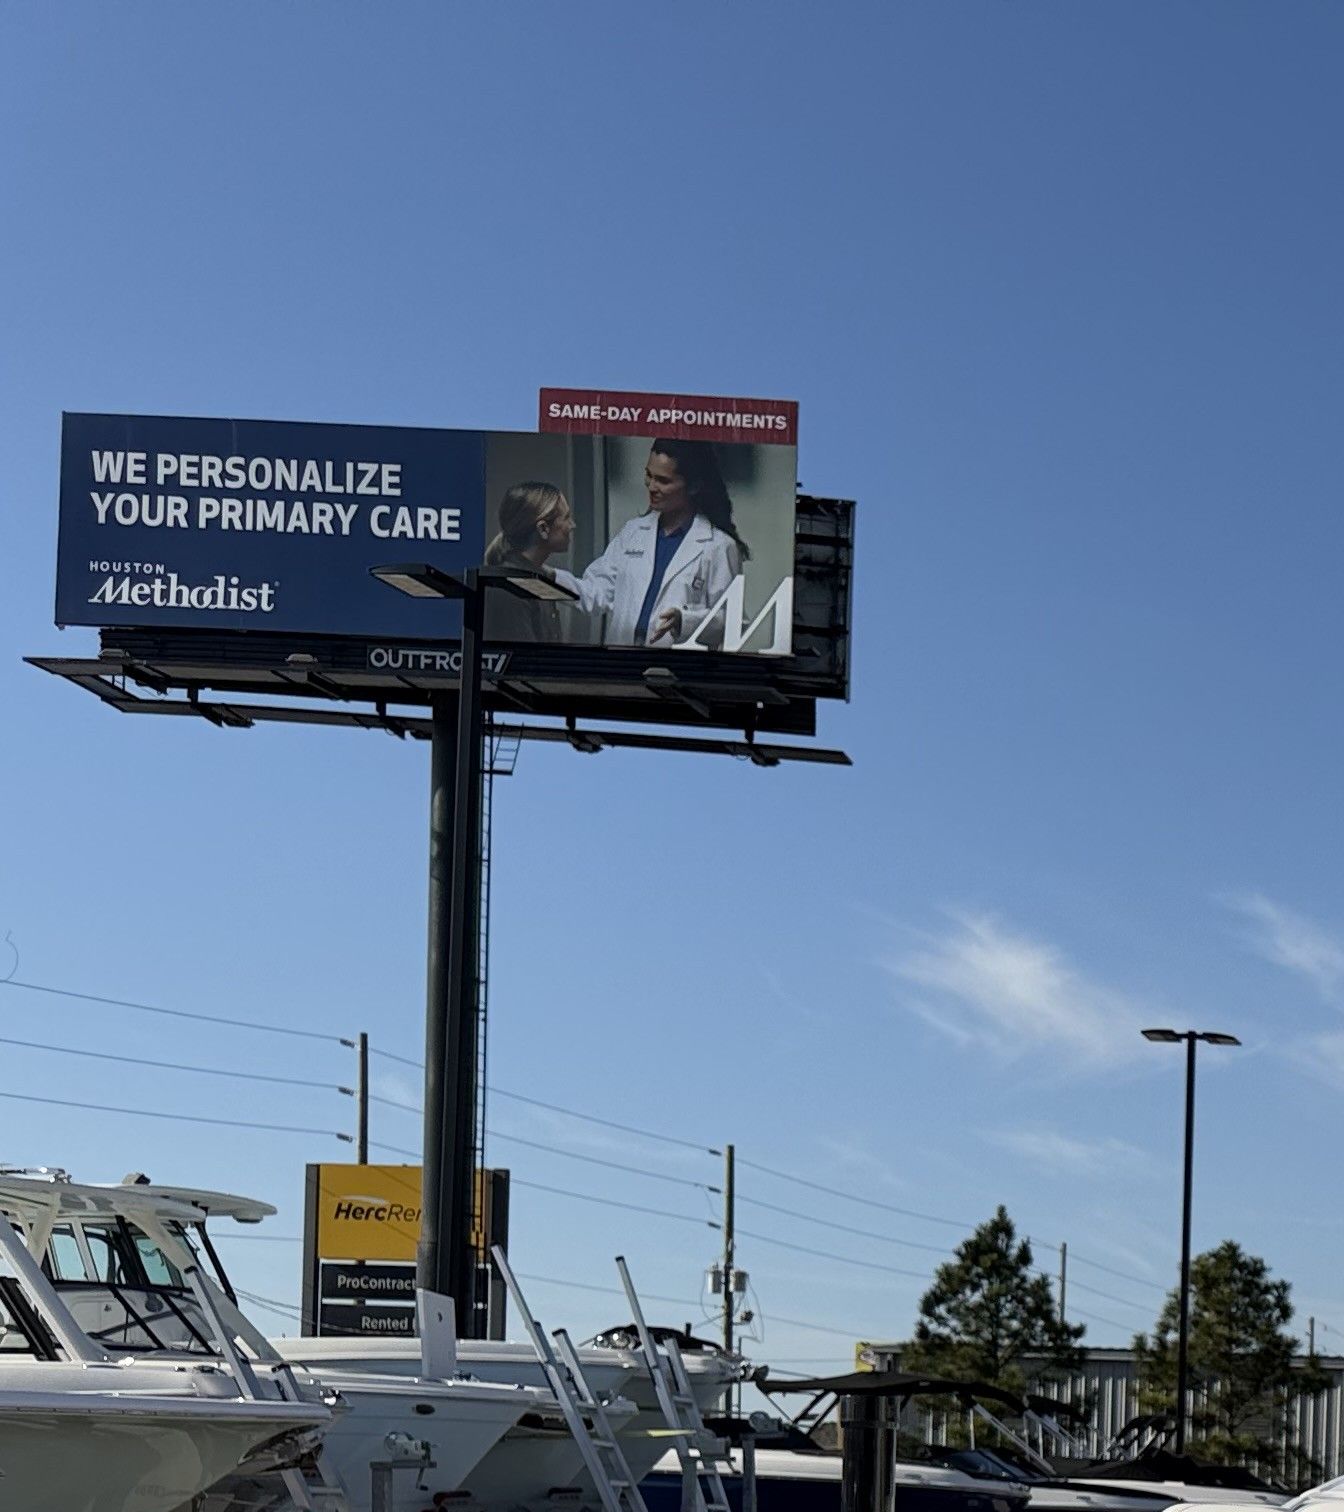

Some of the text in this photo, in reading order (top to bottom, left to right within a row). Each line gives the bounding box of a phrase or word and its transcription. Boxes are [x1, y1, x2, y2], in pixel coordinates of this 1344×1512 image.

[549, 403, 787, 430] SAME-DAY APPOINTMENTS
[91, 450, 402, 496] WE PERSONALIZE
[91, 492, 461, 541] YOUR PRIMARY CARE
[89, 560, 165, 575] HOUSTON
[88, 573, 275, 612] Methodist
[362, 1316, 408, 1330] Rented
